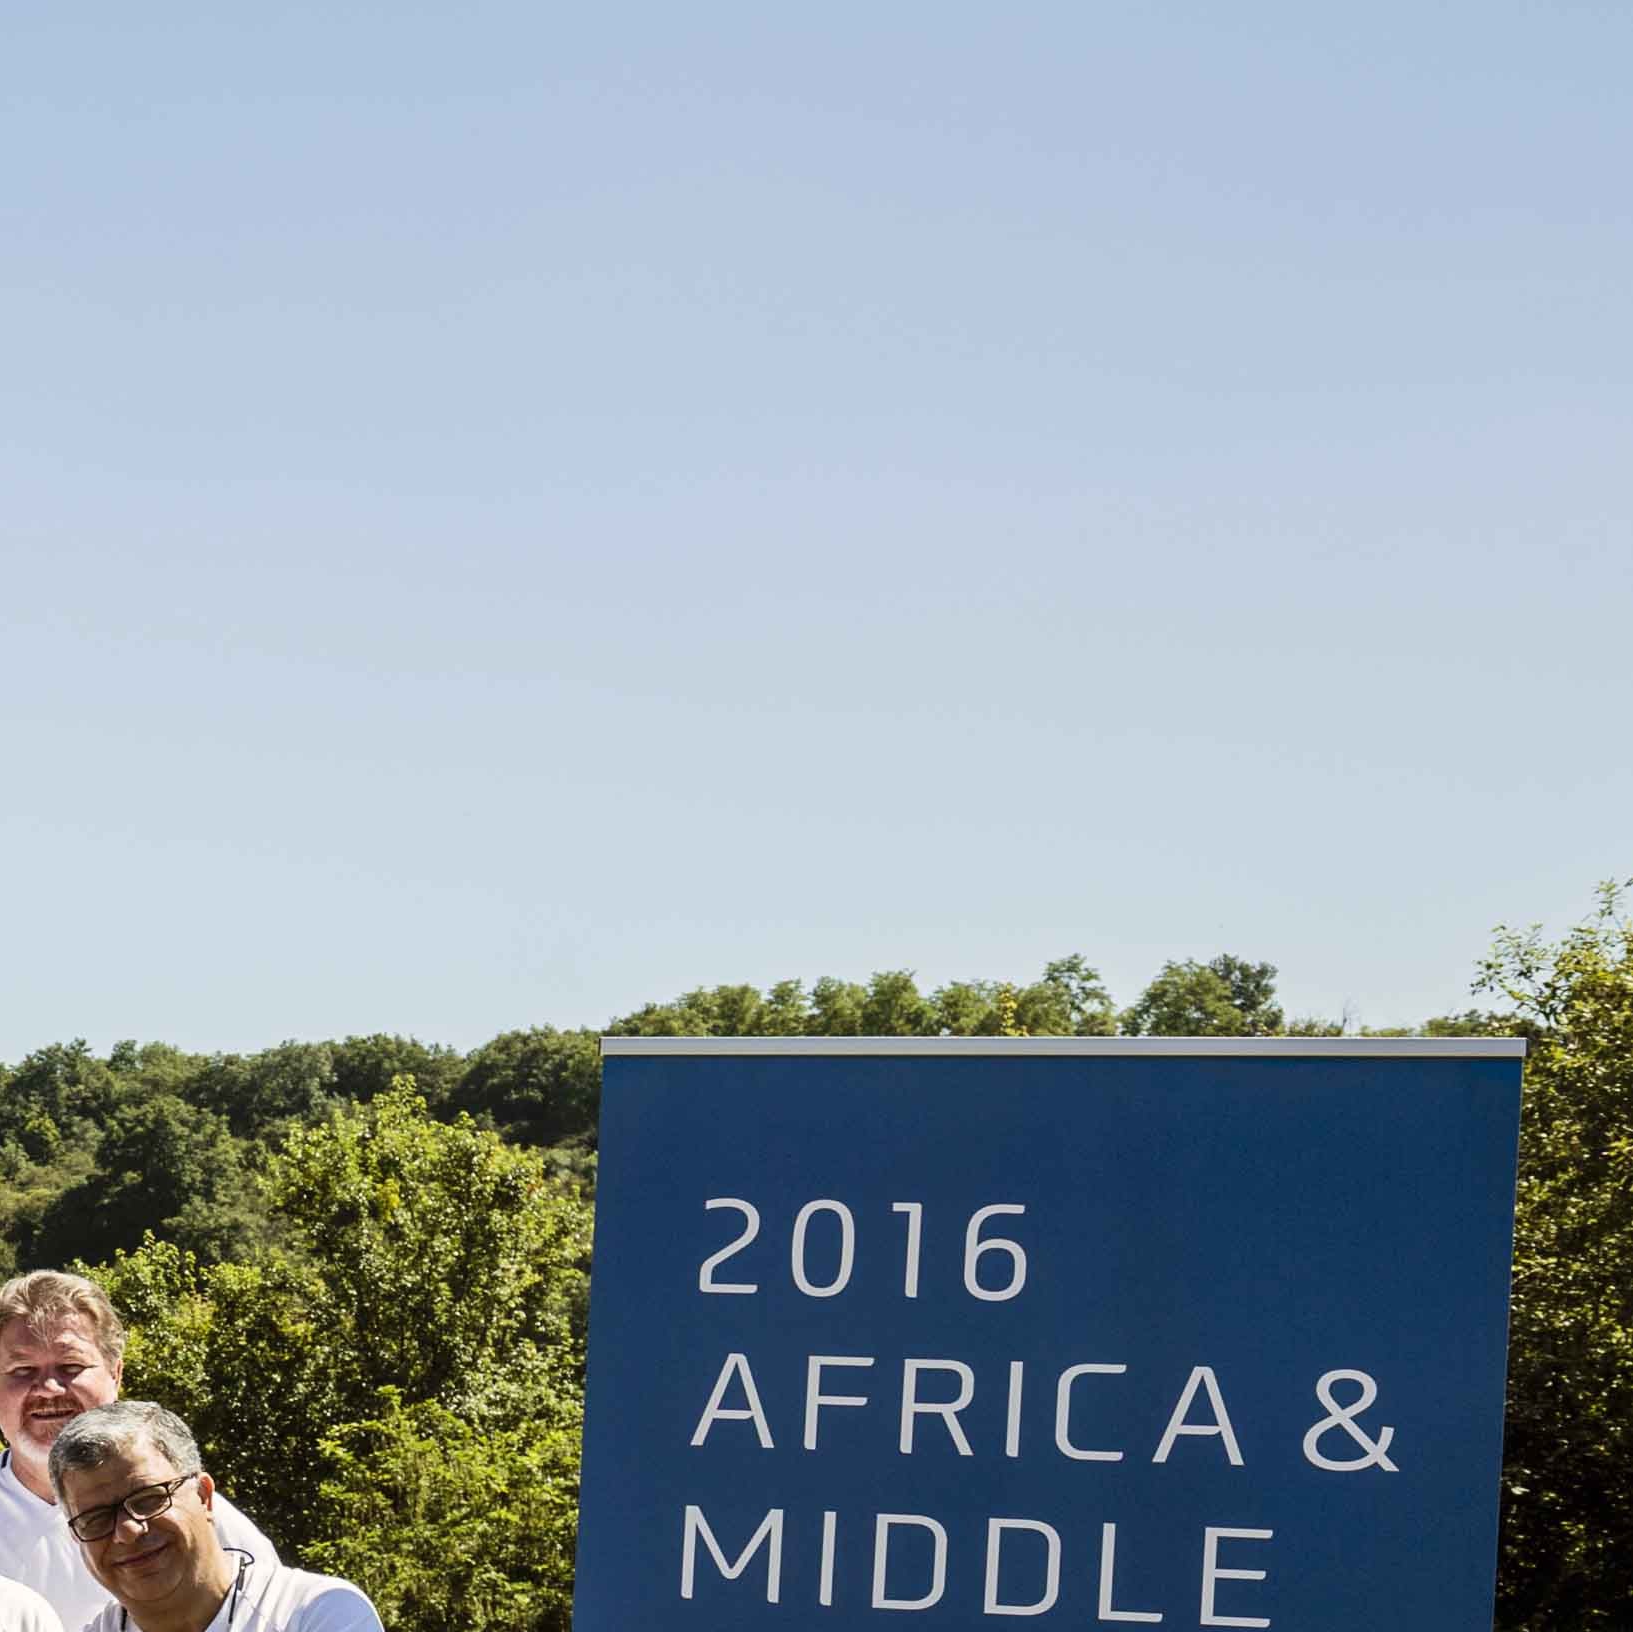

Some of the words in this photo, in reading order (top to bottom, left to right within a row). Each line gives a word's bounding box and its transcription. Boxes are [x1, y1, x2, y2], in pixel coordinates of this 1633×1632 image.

[698, 1197, 1027, 1302] 2016
[689, 1352, 1245, 1466] AFRICA
[1302, 1368, 1400, 1472] &
[680, 1504, 1274, 1628] MIDDLE
